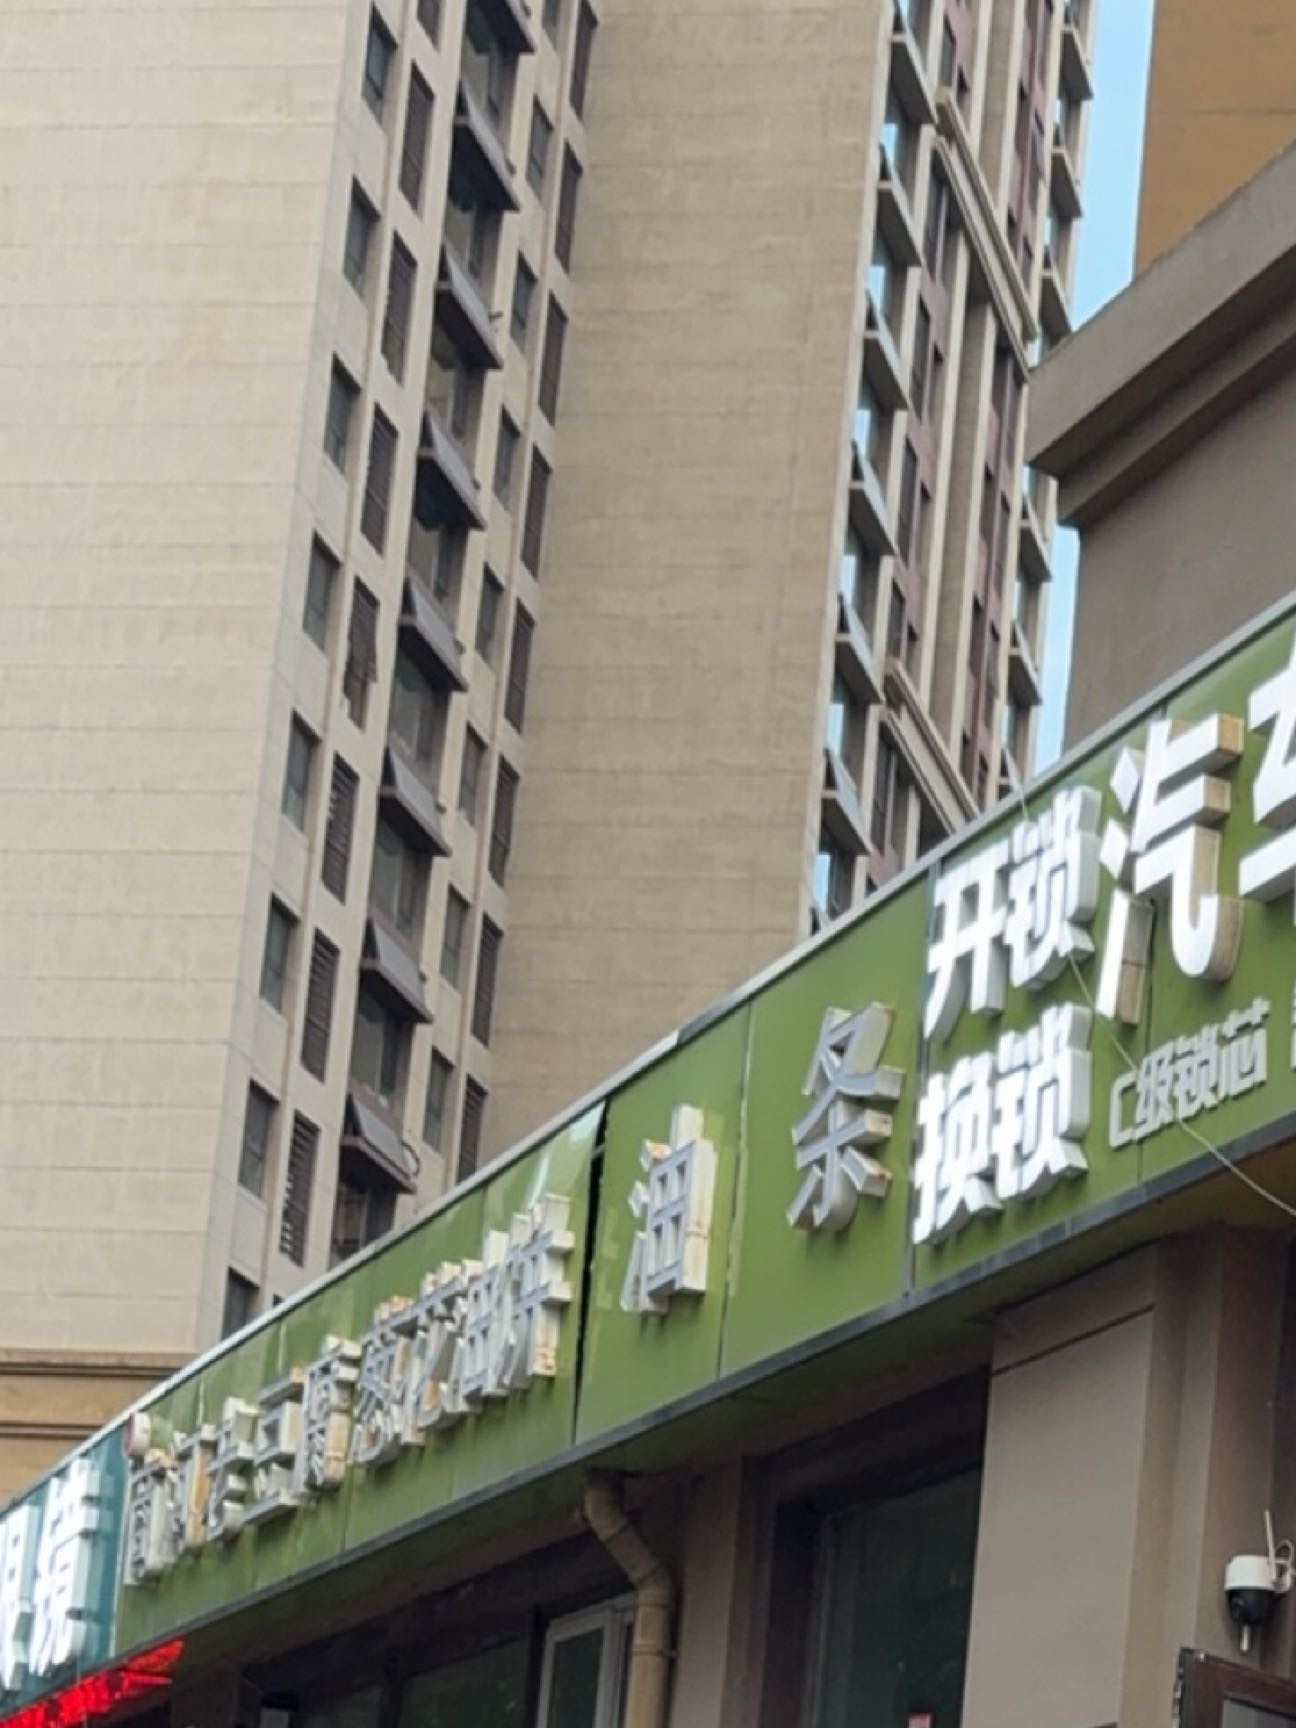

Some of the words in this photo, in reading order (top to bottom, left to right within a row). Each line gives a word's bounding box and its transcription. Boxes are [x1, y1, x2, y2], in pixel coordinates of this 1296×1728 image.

[924, 786, 1101, 1040] 开锁
[913, 1002, 1093, 1246] 换锁
[1108, 998, 1271, 1148] C级锁芯
